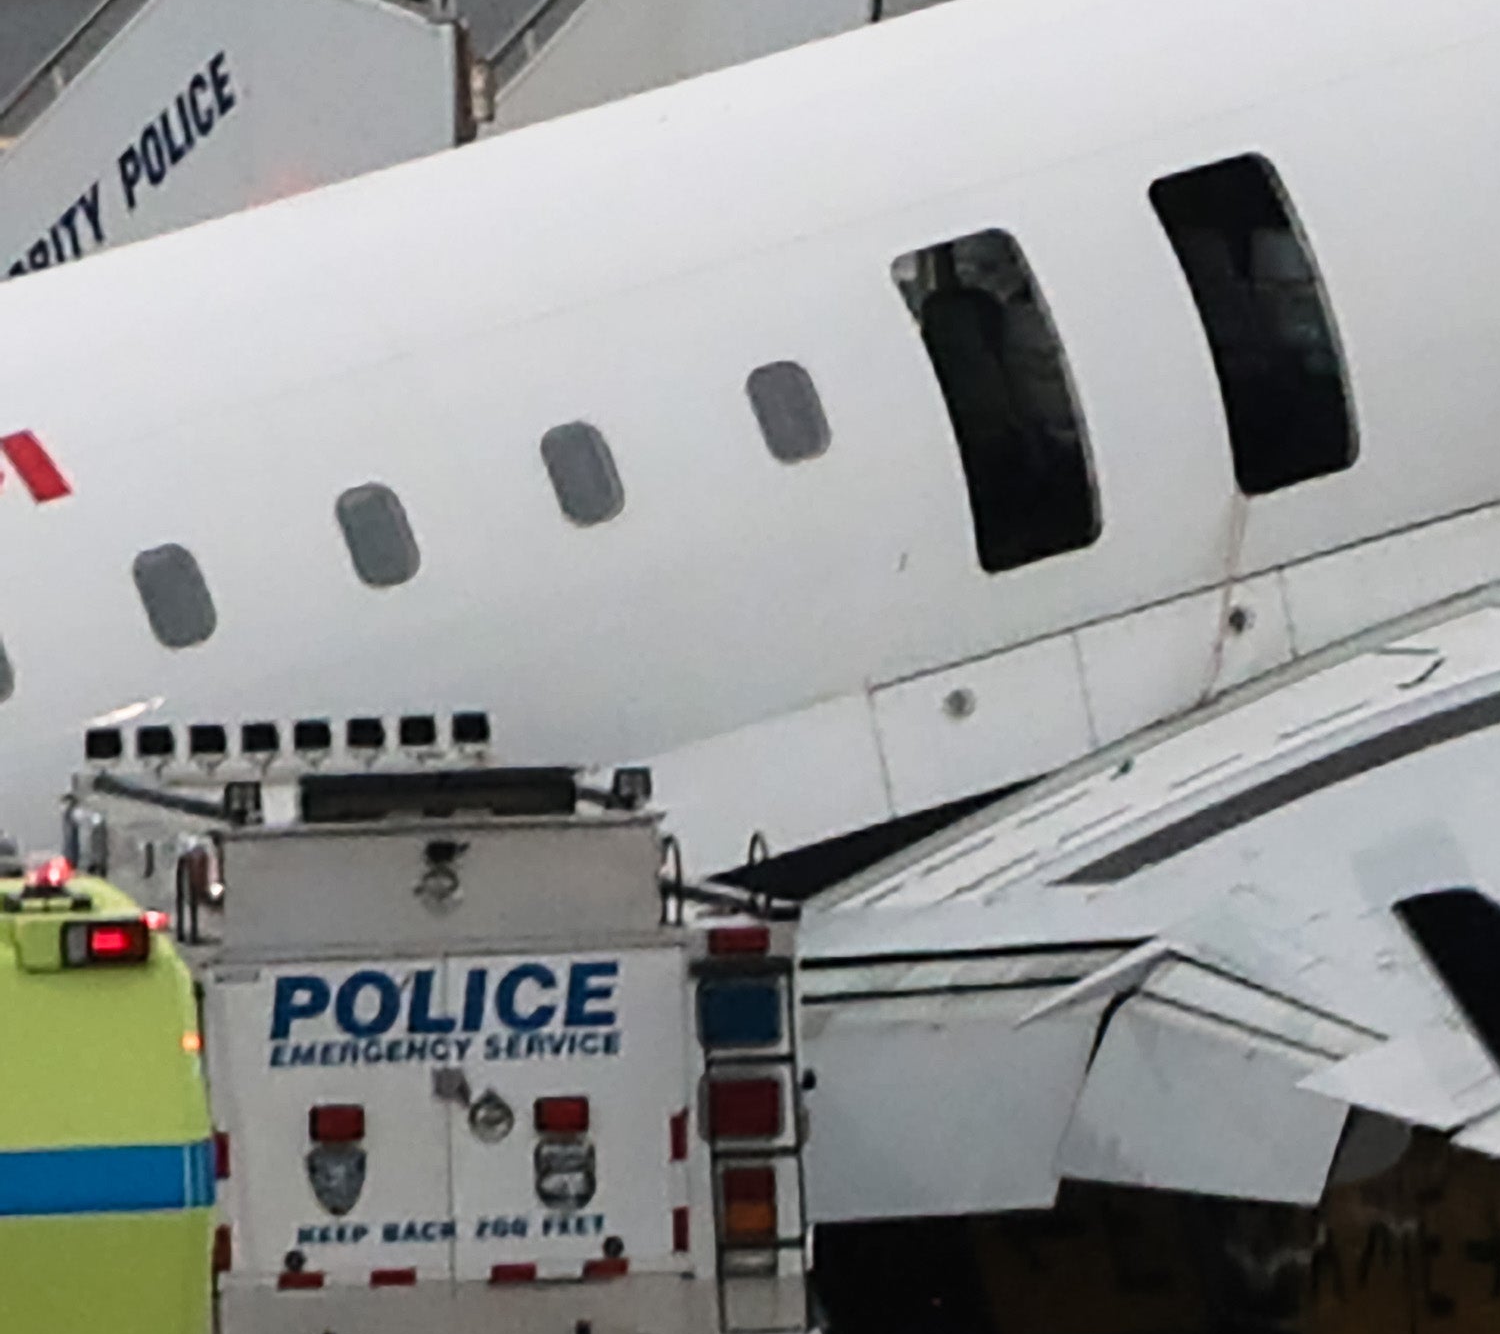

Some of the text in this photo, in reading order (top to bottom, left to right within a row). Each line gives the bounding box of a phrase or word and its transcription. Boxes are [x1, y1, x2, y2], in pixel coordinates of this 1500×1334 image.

[117, 50, 237, 210] POLICE
[269, 961, 619, 1041] POLICE
[269, 1032, 622, 1067] EMERGENCY SERVICE
